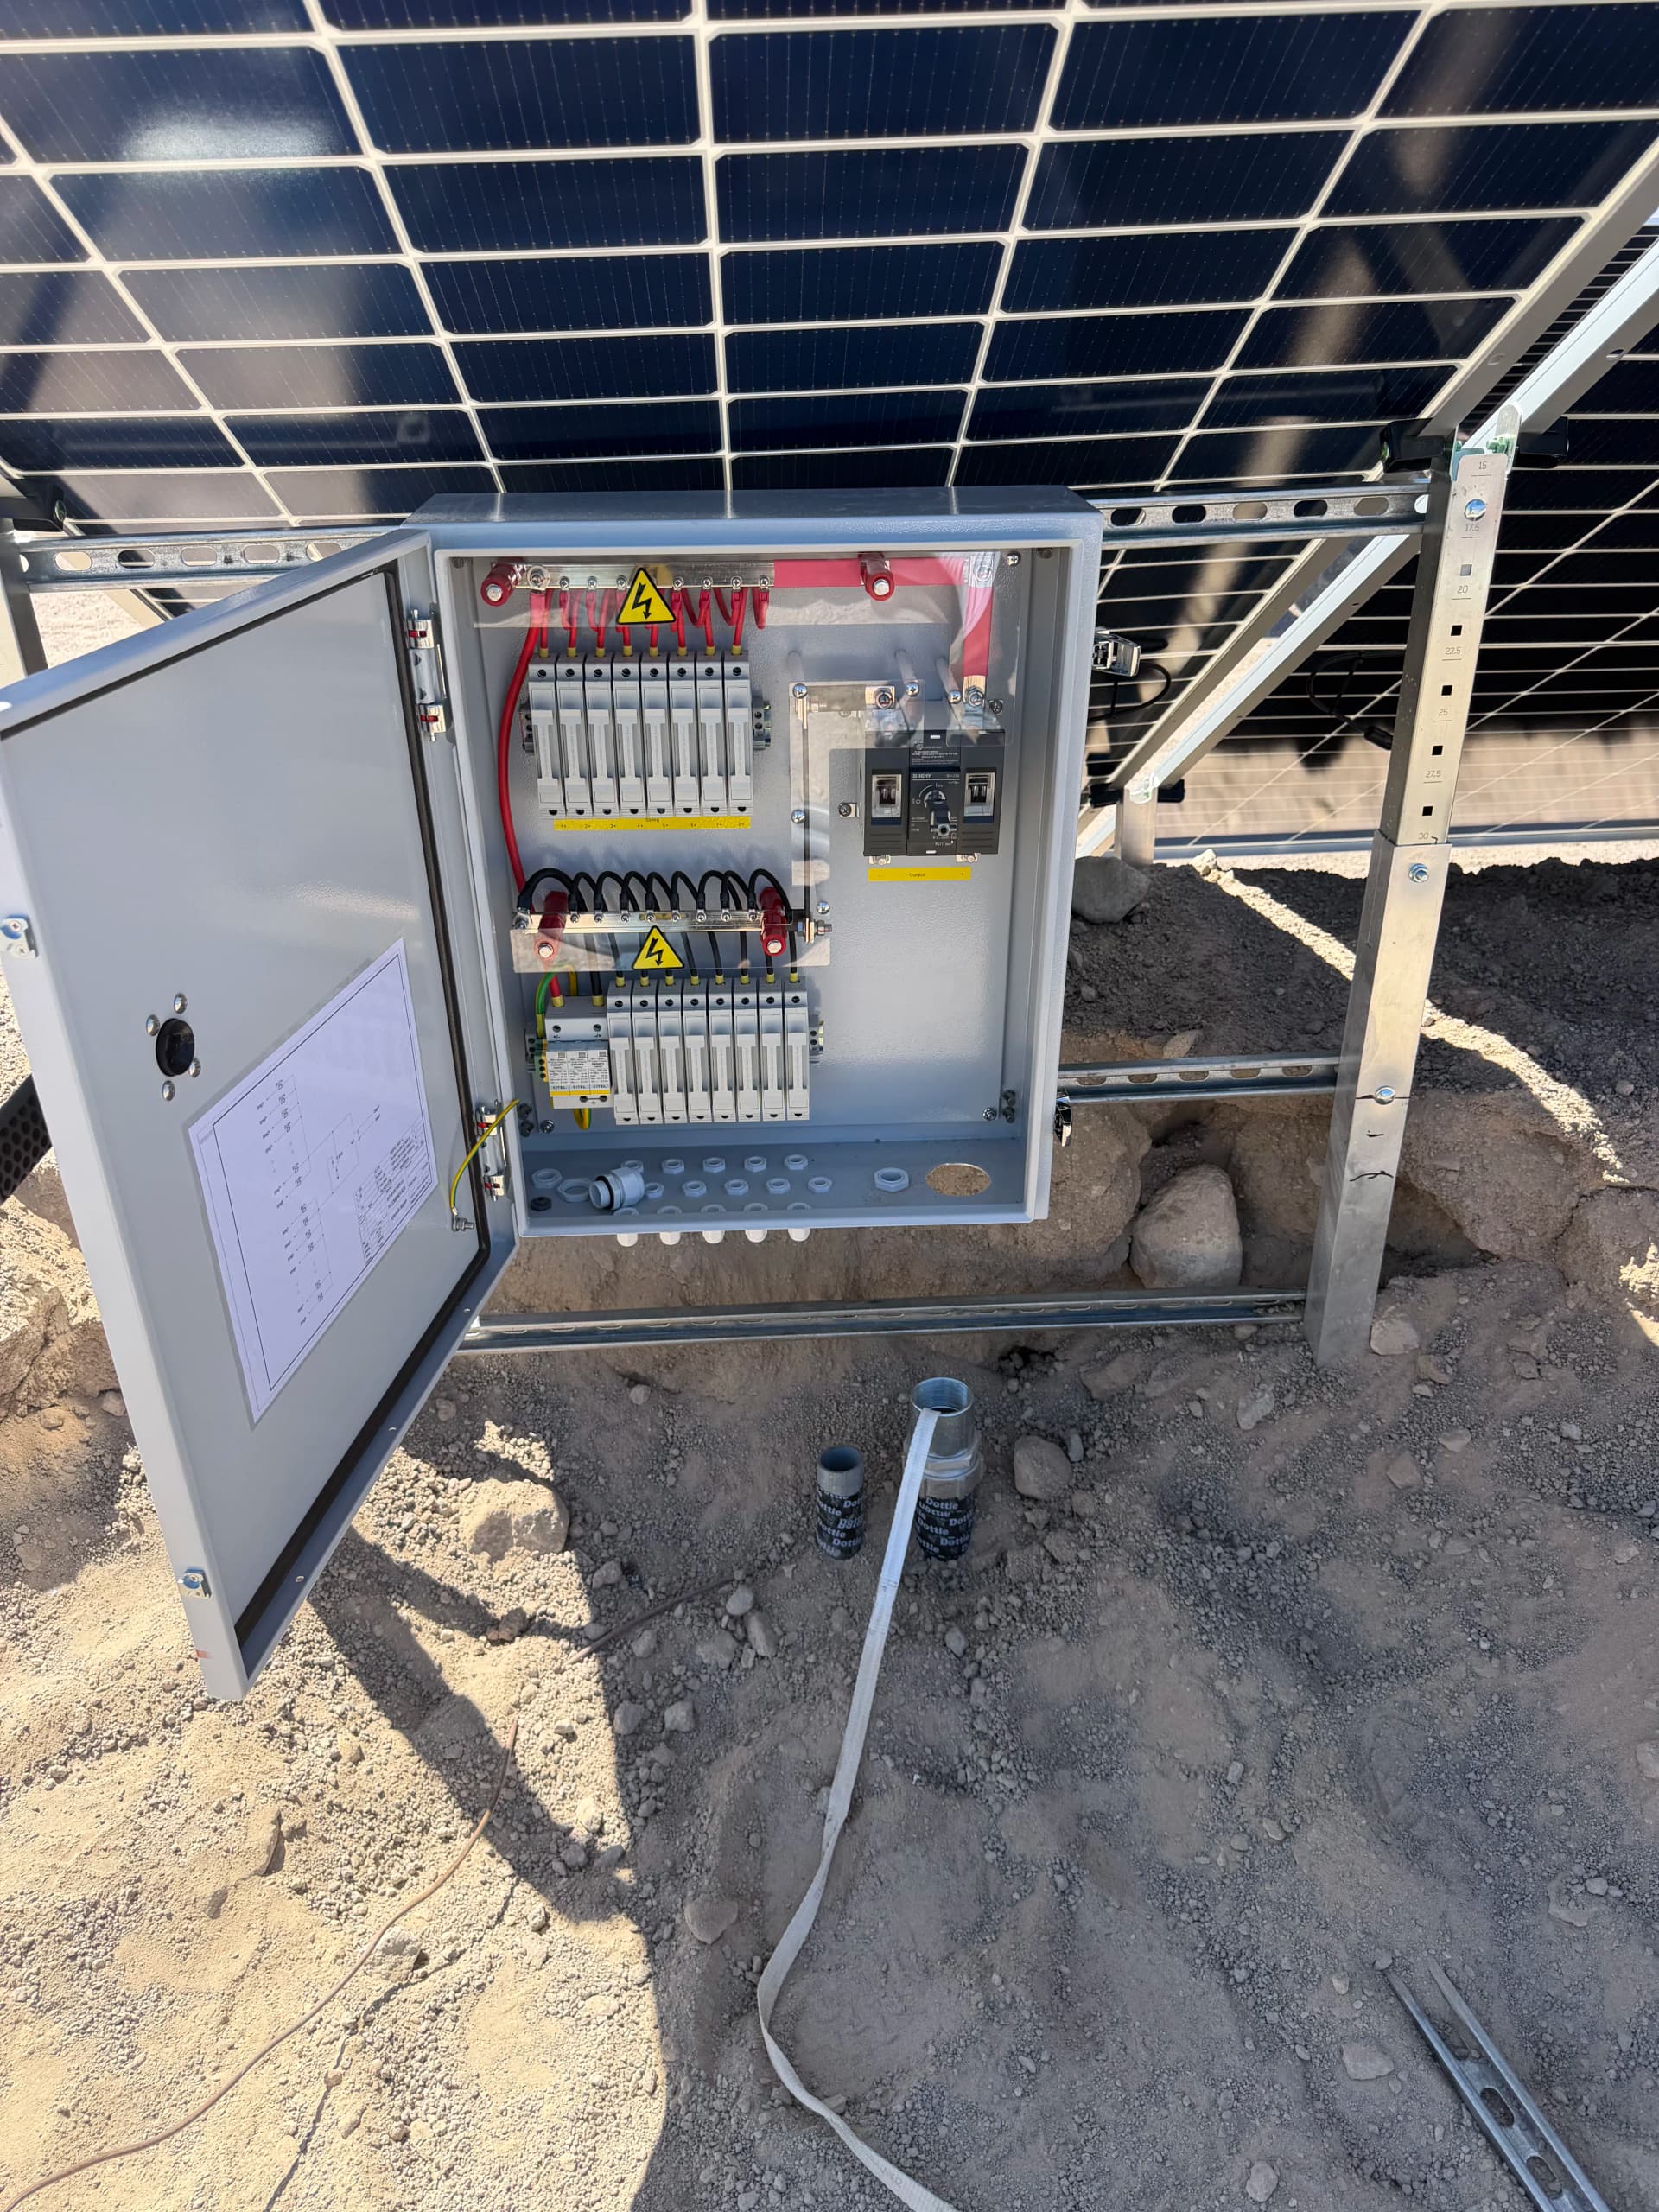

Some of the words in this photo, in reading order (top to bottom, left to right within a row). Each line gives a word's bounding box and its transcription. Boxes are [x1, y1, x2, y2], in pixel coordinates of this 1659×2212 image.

[1478, 461, 1487, 470] 15
[1465, 523, 1480, 532] 17.5
[1457, 585, 1469, 594] 20
[1445, 646, 1461, 655] 22.5
[1438, 708, 1448, 716] 25
[1425, 769, 1441, 778] 27.5
[925, 1497, 958, 1510] Dottie
